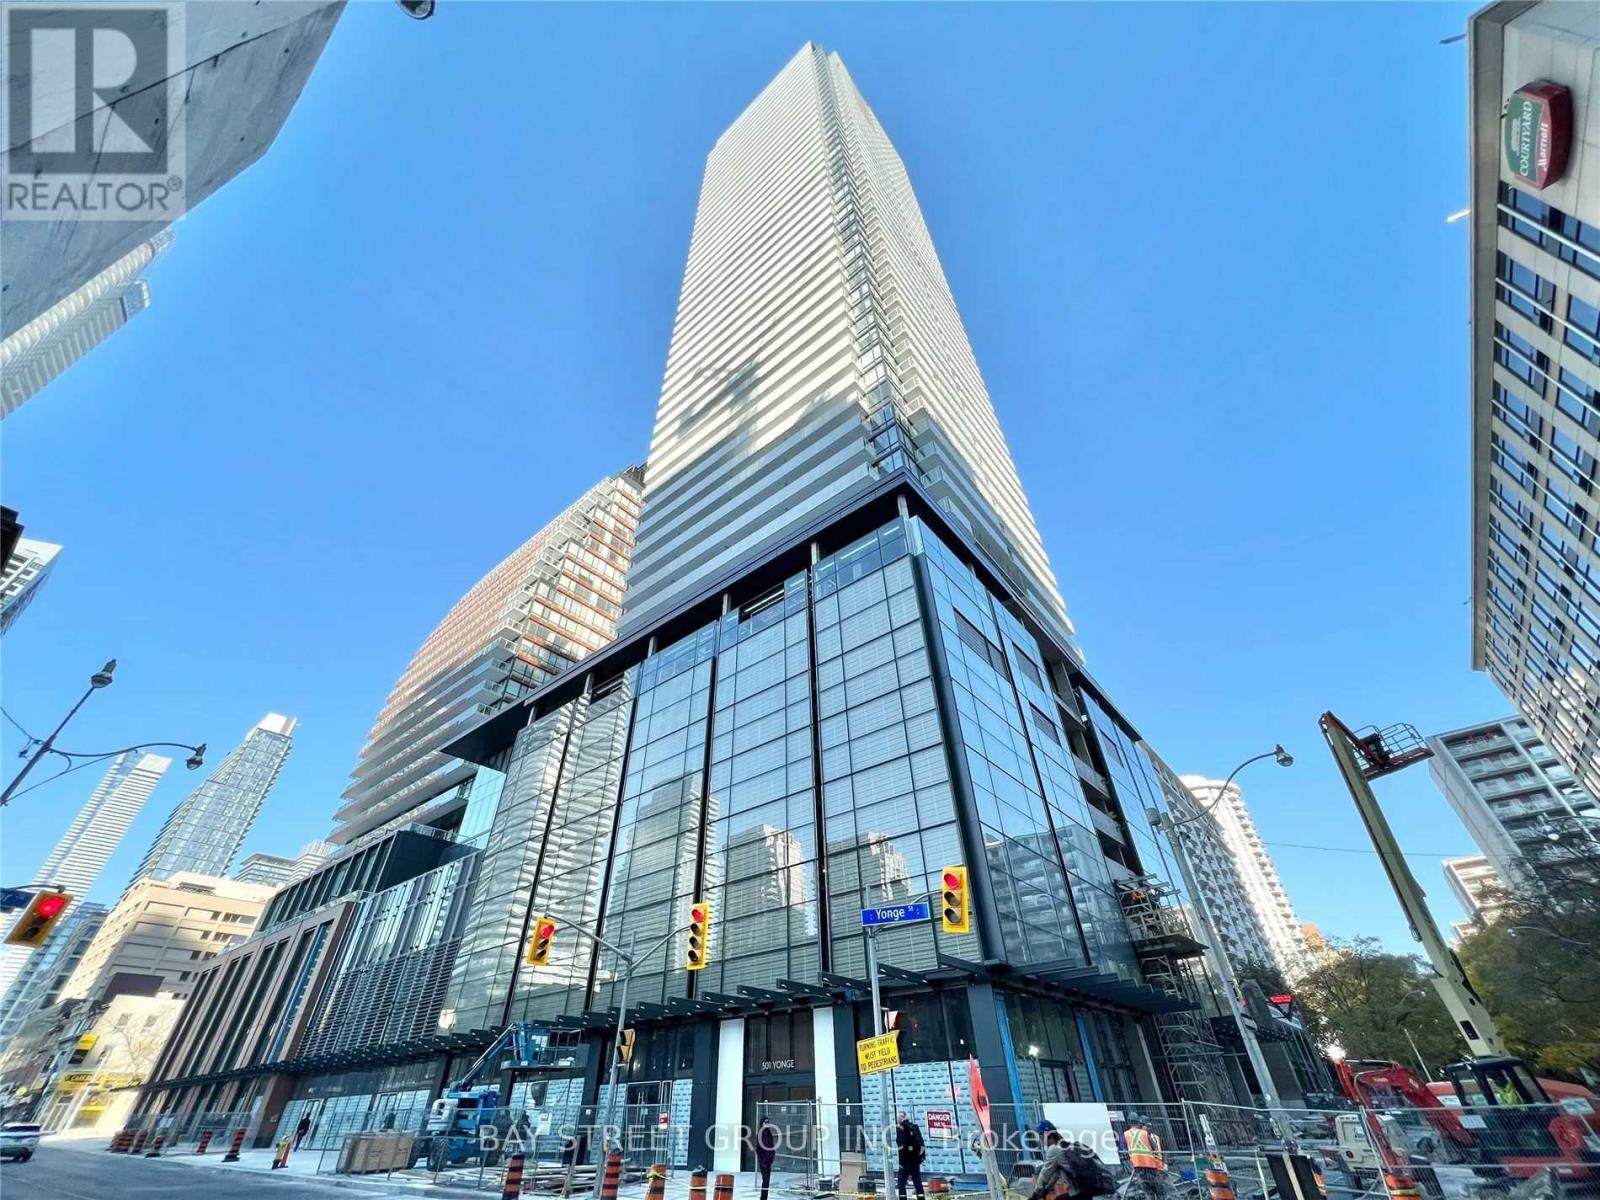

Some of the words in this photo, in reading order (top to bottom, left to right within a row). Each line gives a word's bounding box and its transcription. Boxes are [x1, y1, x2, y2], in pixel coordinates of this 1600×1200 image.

[1520, 101, 1533, 176] COURTYARD
[1538, 122, 1549, 172] Marriott
[876, 909, 905, 920] Yonge
[859, 1040, 876, 1051] TURNING
[877, 1036, 895, 1046] TRAFFIC
[865, 1051, 876, 1060] MUST
[878, 1048, 891, 1056] YIELD
[772, 1059, 795, 1069] YONGE
[861, 1063, 867, 1071] TO
[868, 1056, 898, 1069] PEDESTRIANS
[928, 1113, 951, 1121] DANGER
